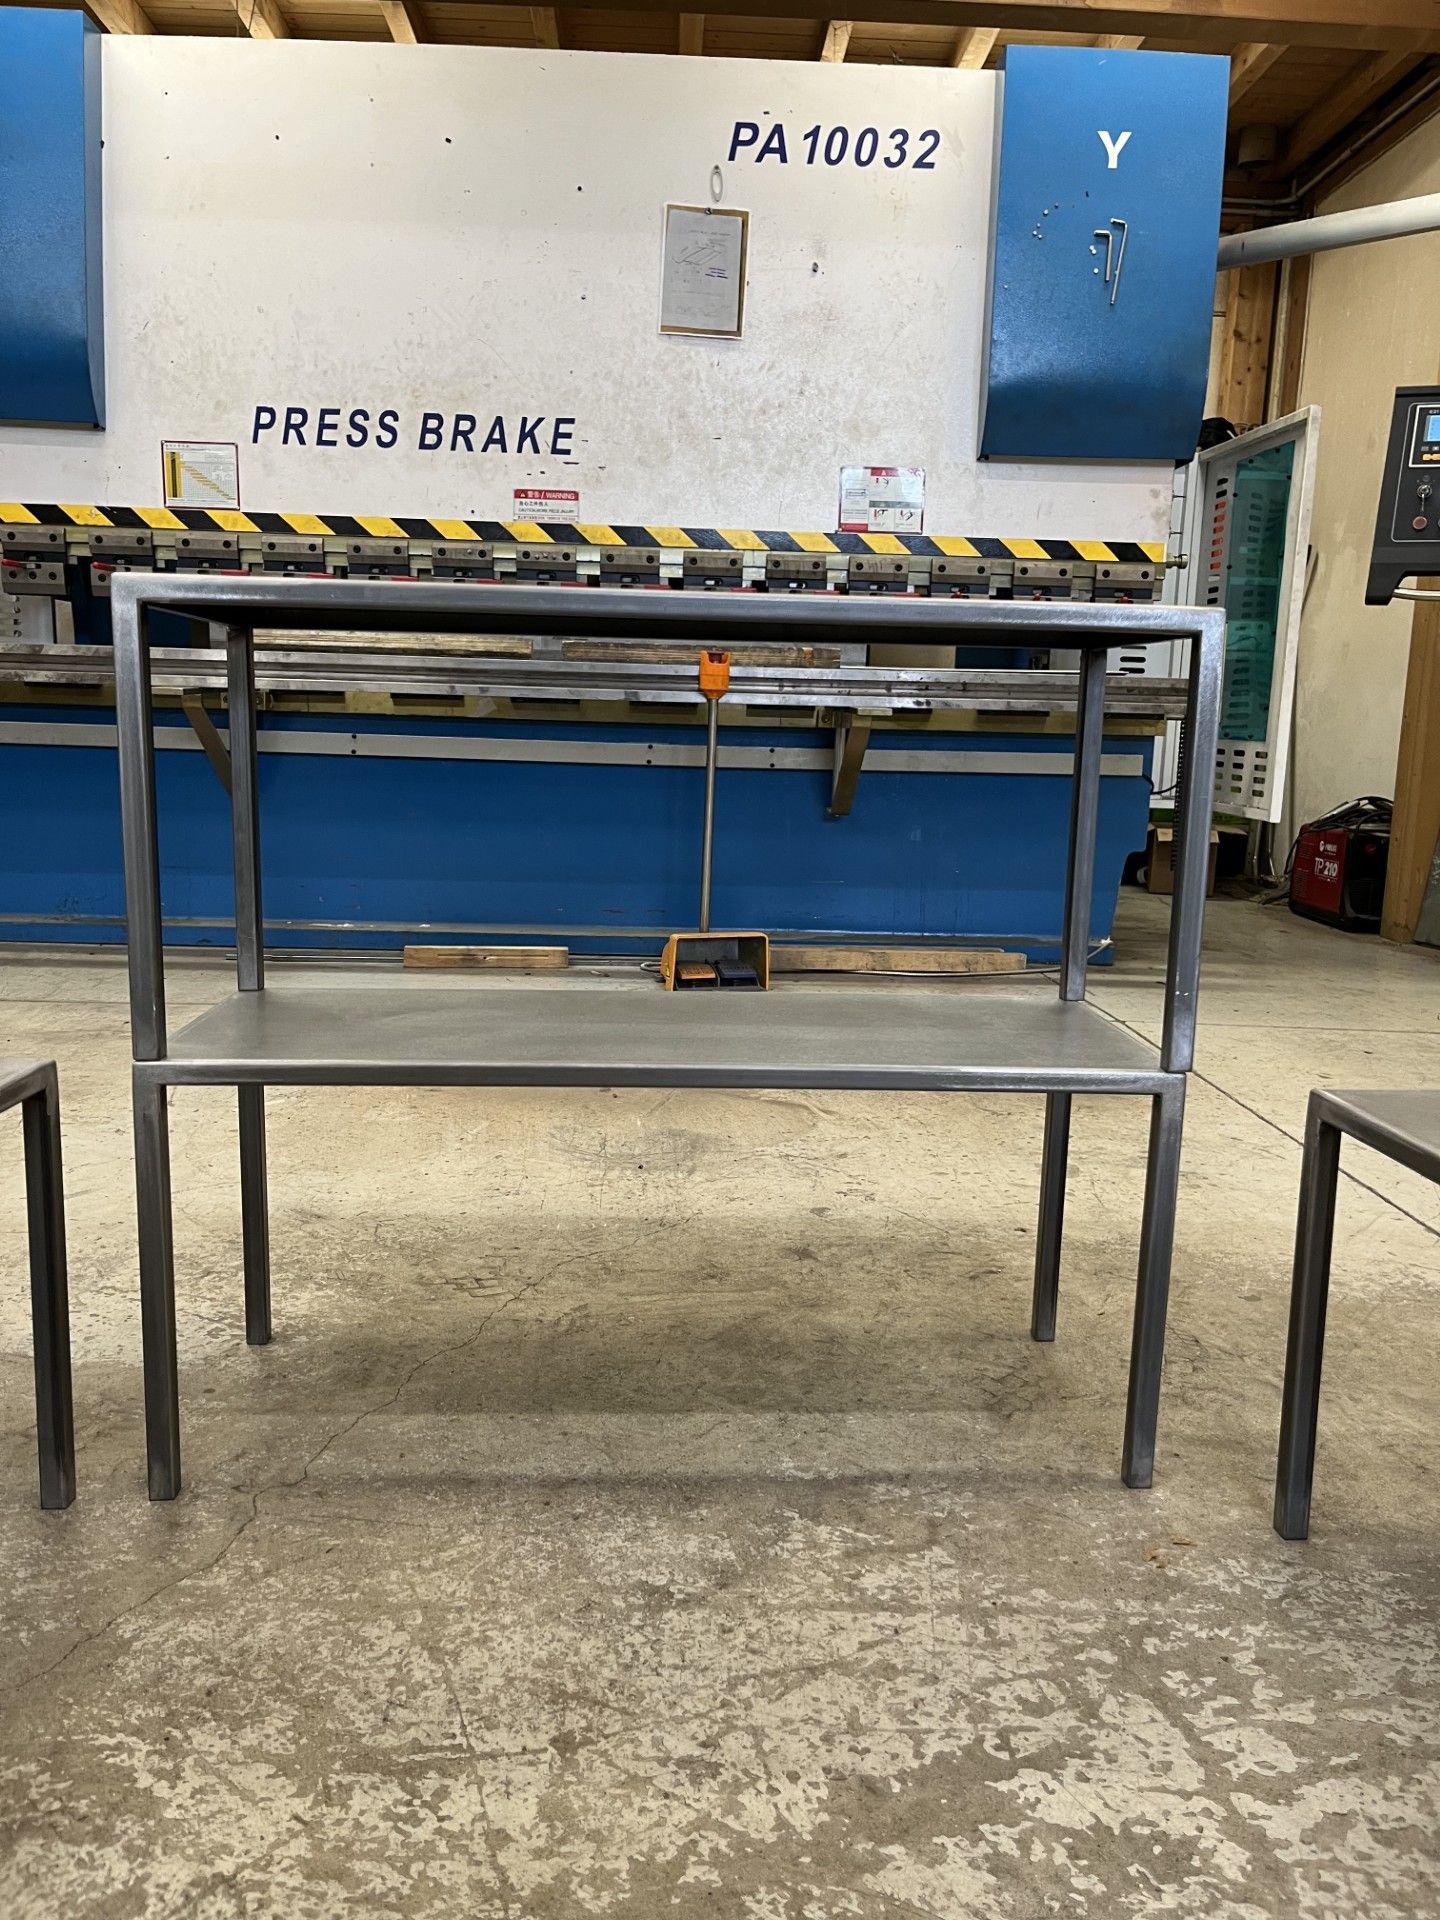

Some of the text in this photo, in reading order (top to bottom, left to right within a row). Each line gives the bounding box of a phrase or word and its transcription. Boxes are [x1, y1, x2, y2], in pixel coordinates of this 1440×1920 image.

[728, 121, 941, 170] PA 10032
[1096, 130, 1133, 169] Y
[252, 406, 576, 456] PRESS BRAKE
[545, 492, 575, 500] WARNING
[1314, 857, 1338, 877] TP 210
